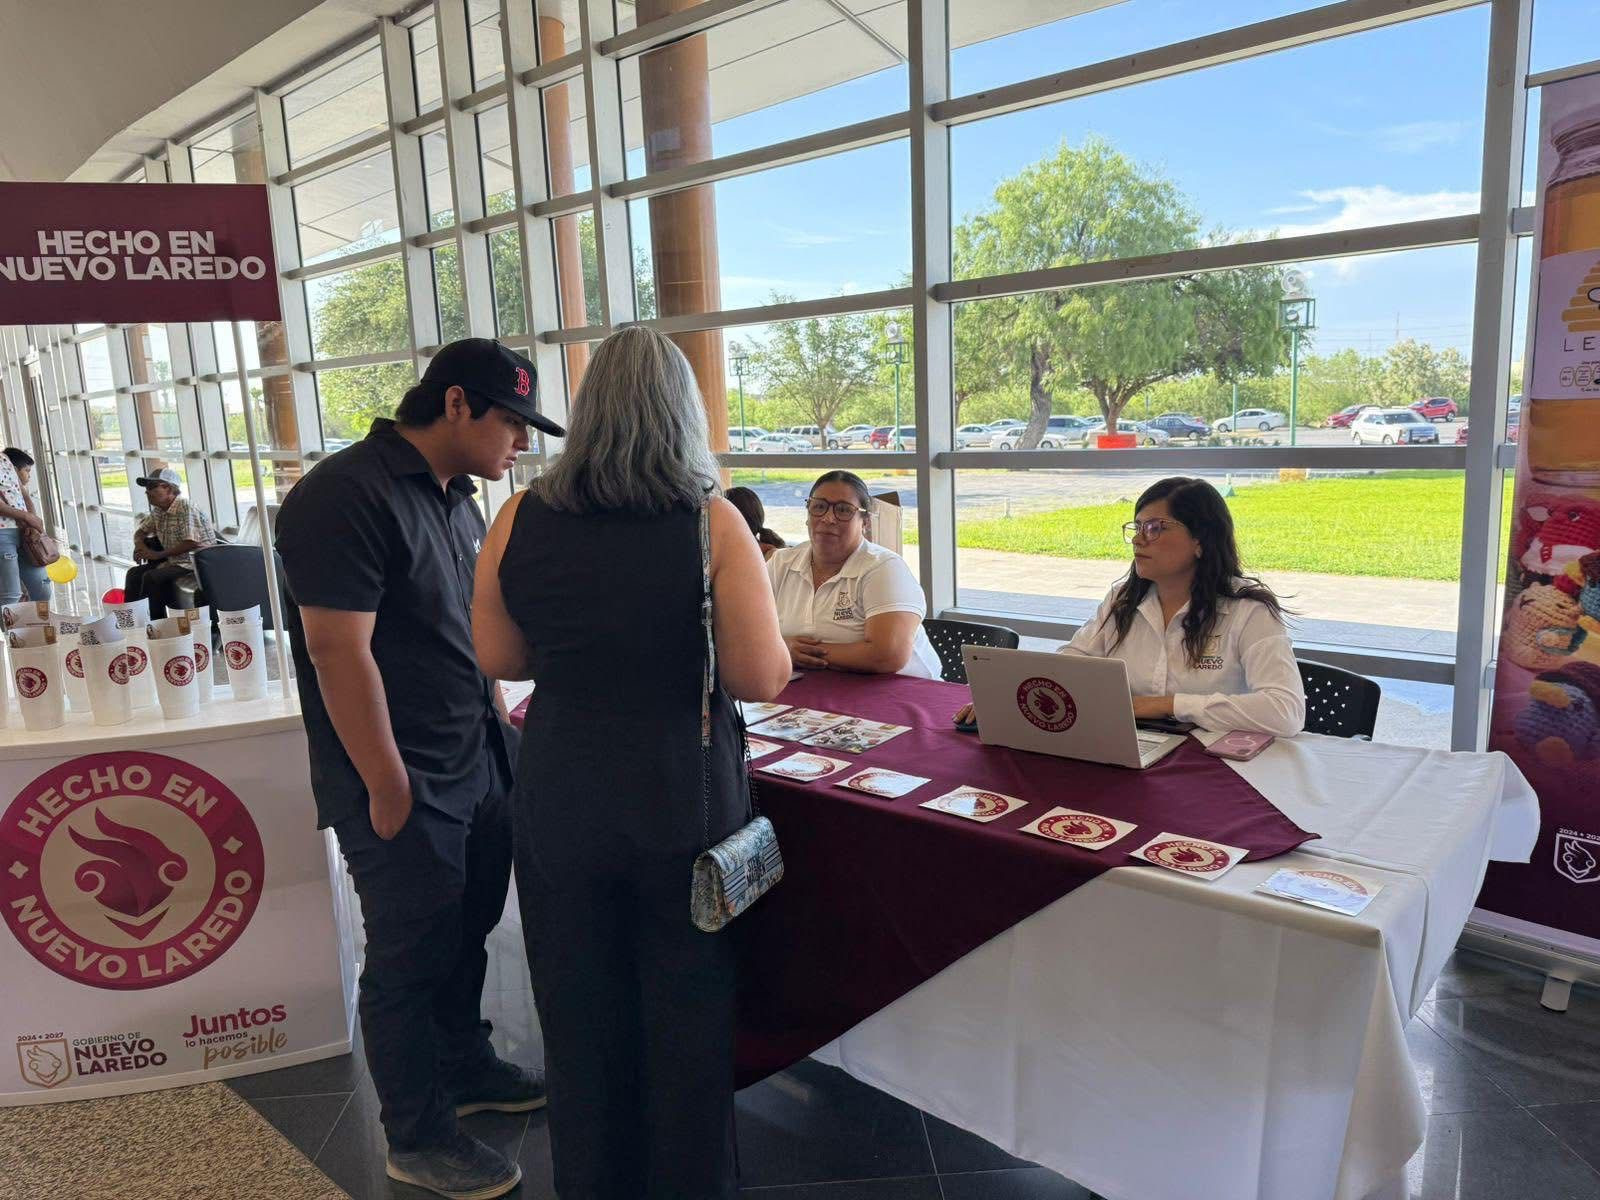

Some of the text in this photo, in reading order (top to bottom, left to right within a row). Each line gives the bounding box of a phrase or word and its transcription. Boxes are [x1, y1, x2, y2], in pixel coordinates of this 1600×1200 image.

[37, 230, 216, 255] HECHO EN
[0, 256, 267, 281] NUEVO LAREDO
[514, 366, 530, 397] B
[1024, 680, 1068, 698] HECHO EN
[17, 765, 218, 837] HECHO EN
[10, 869, 252, 979] NUEVO LAREDO
[182, 1004, 287, 1038] Juntos
[17, 1032, 64, 1042] 2024 2027
[72, 1032, 141, 1047] GOBIERNO DE
[74, 1038, 155, 1061] NUEVO
[185, 1031, 248, 1048] lo hacemos
[203, 1027, 288, 1070] posible
[76, 1052, 168, 1076] LAREDO
